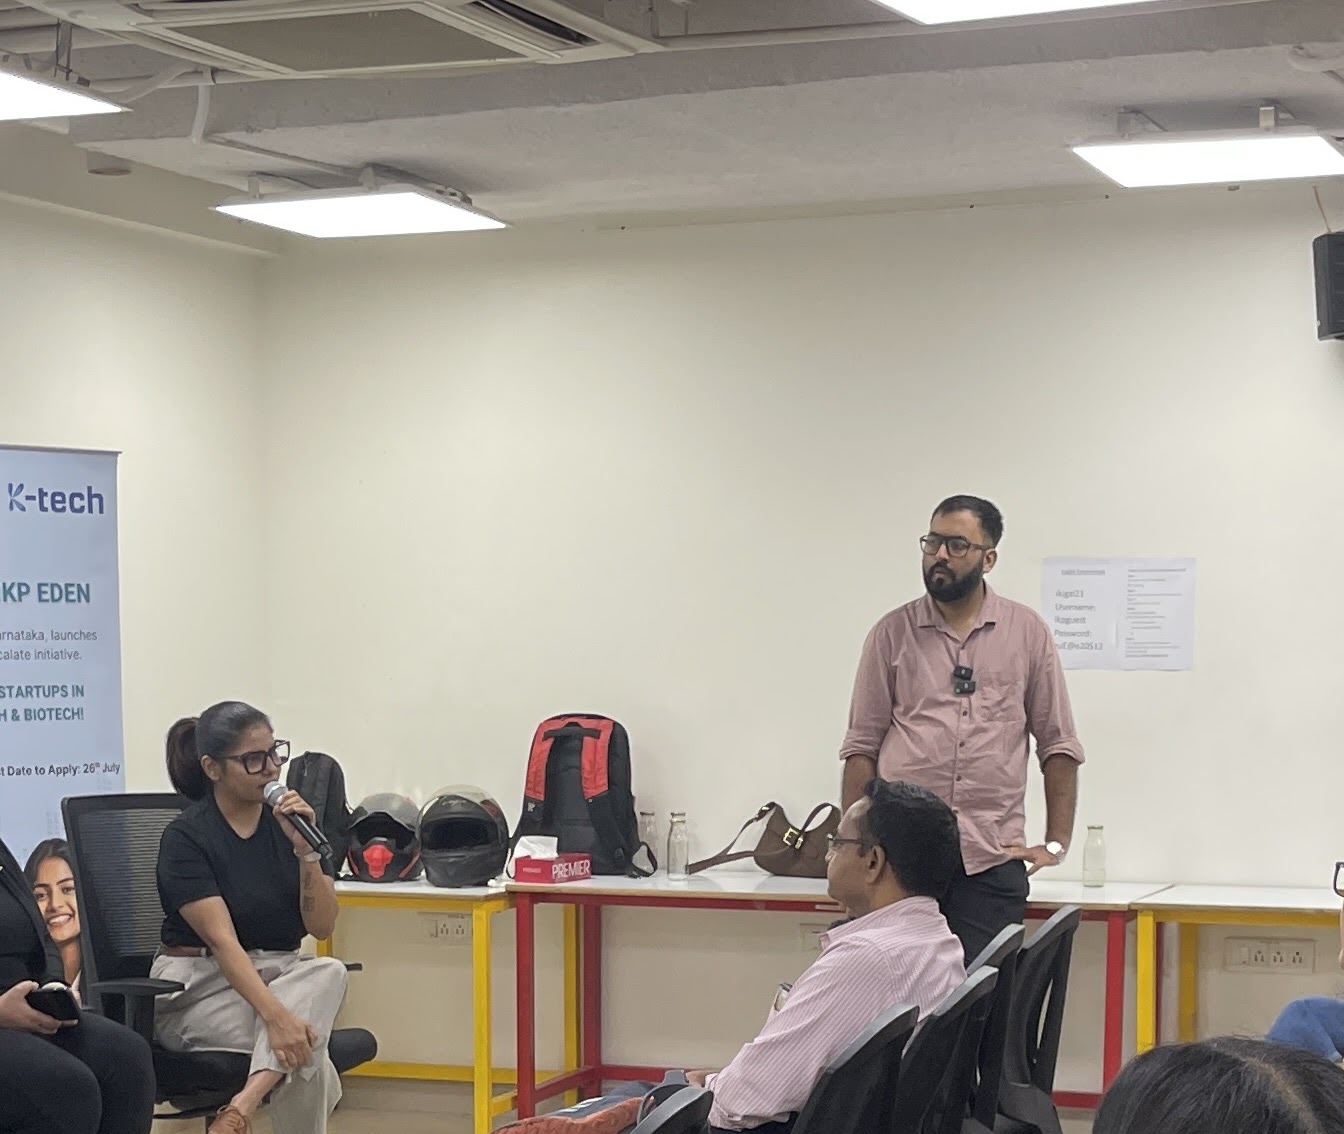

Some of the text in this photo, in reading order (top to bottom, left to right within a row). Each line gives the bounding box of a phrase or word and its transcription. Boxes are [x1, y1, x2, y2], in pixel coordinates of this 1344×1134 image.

[8, 483, 104, 514] K-tech
[37, 582, 90, 604] EDEN
[50, 629, 98, 641] launches
[34, 648, 82, 660] initiative.
[72, 685, 84, 698] IN
[11, 708, 20, 722] &
[24, 707, 84, 721] BIOTECH!
[8, 766, 32, 776] Date
[35, 766, 46, 776] to
[48, 764, 80, 778] Apply:
[102, 762, 120, 774] July
[552, 860, 590, 880] PREMIER
